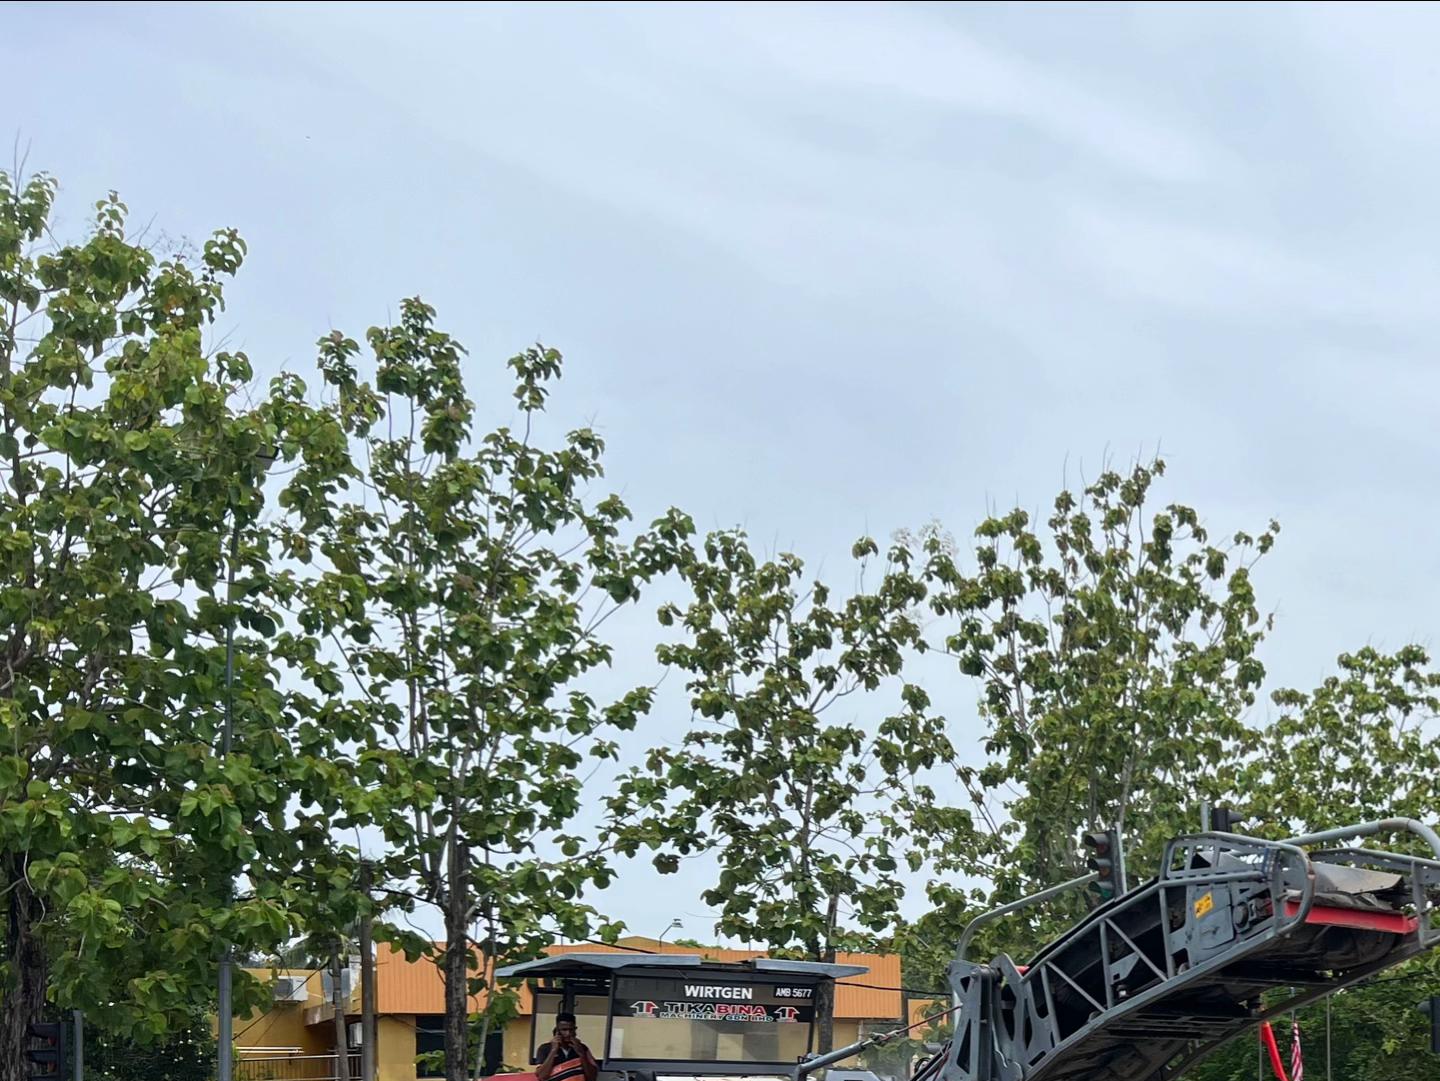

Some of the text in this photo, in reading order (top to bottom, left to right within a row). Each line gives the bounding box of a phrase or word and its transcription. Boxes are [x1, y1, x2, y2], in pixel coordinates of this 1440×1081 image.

[684, 984, 812, 1000] WIRTGEN AMB 5677
[663, 1001, 767, 1016] TIKABINA
[659, 1012, 724, 1020] MACHINERY
[726, 1013, 750, 1021] SDN
[751, 1014, 774, 1022] BHD
